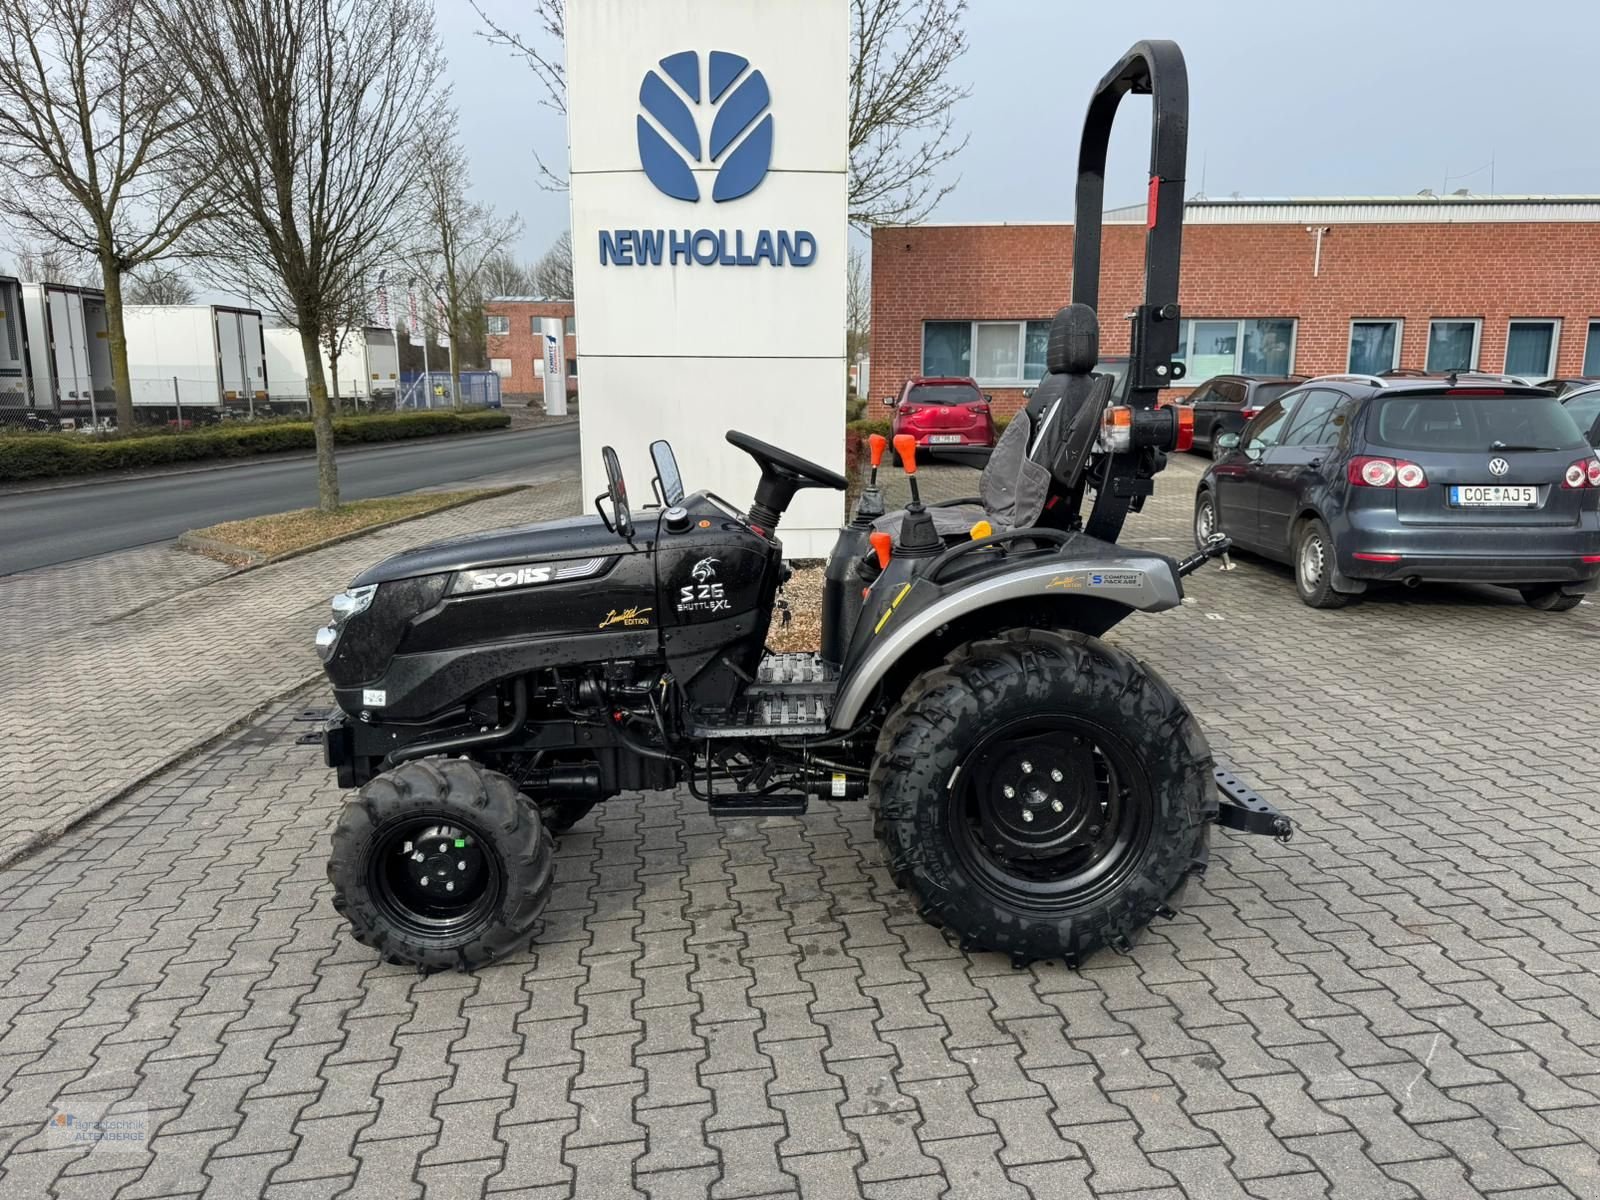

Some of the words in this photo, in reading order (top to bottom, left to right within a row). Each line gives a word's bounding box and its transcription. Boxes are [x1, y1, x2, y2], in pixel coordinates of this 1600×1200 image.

[598, 229, 664, 266] NEW
[669, 229, 817, 267] HOLLAND
[1464, 487, 1493, 502] COE
[1092, 574, 1103, 585] S
[680, 585, 695, 602] S
[697, 583, 724, 599] 26
[624, 618, 650, 627] EDITION
